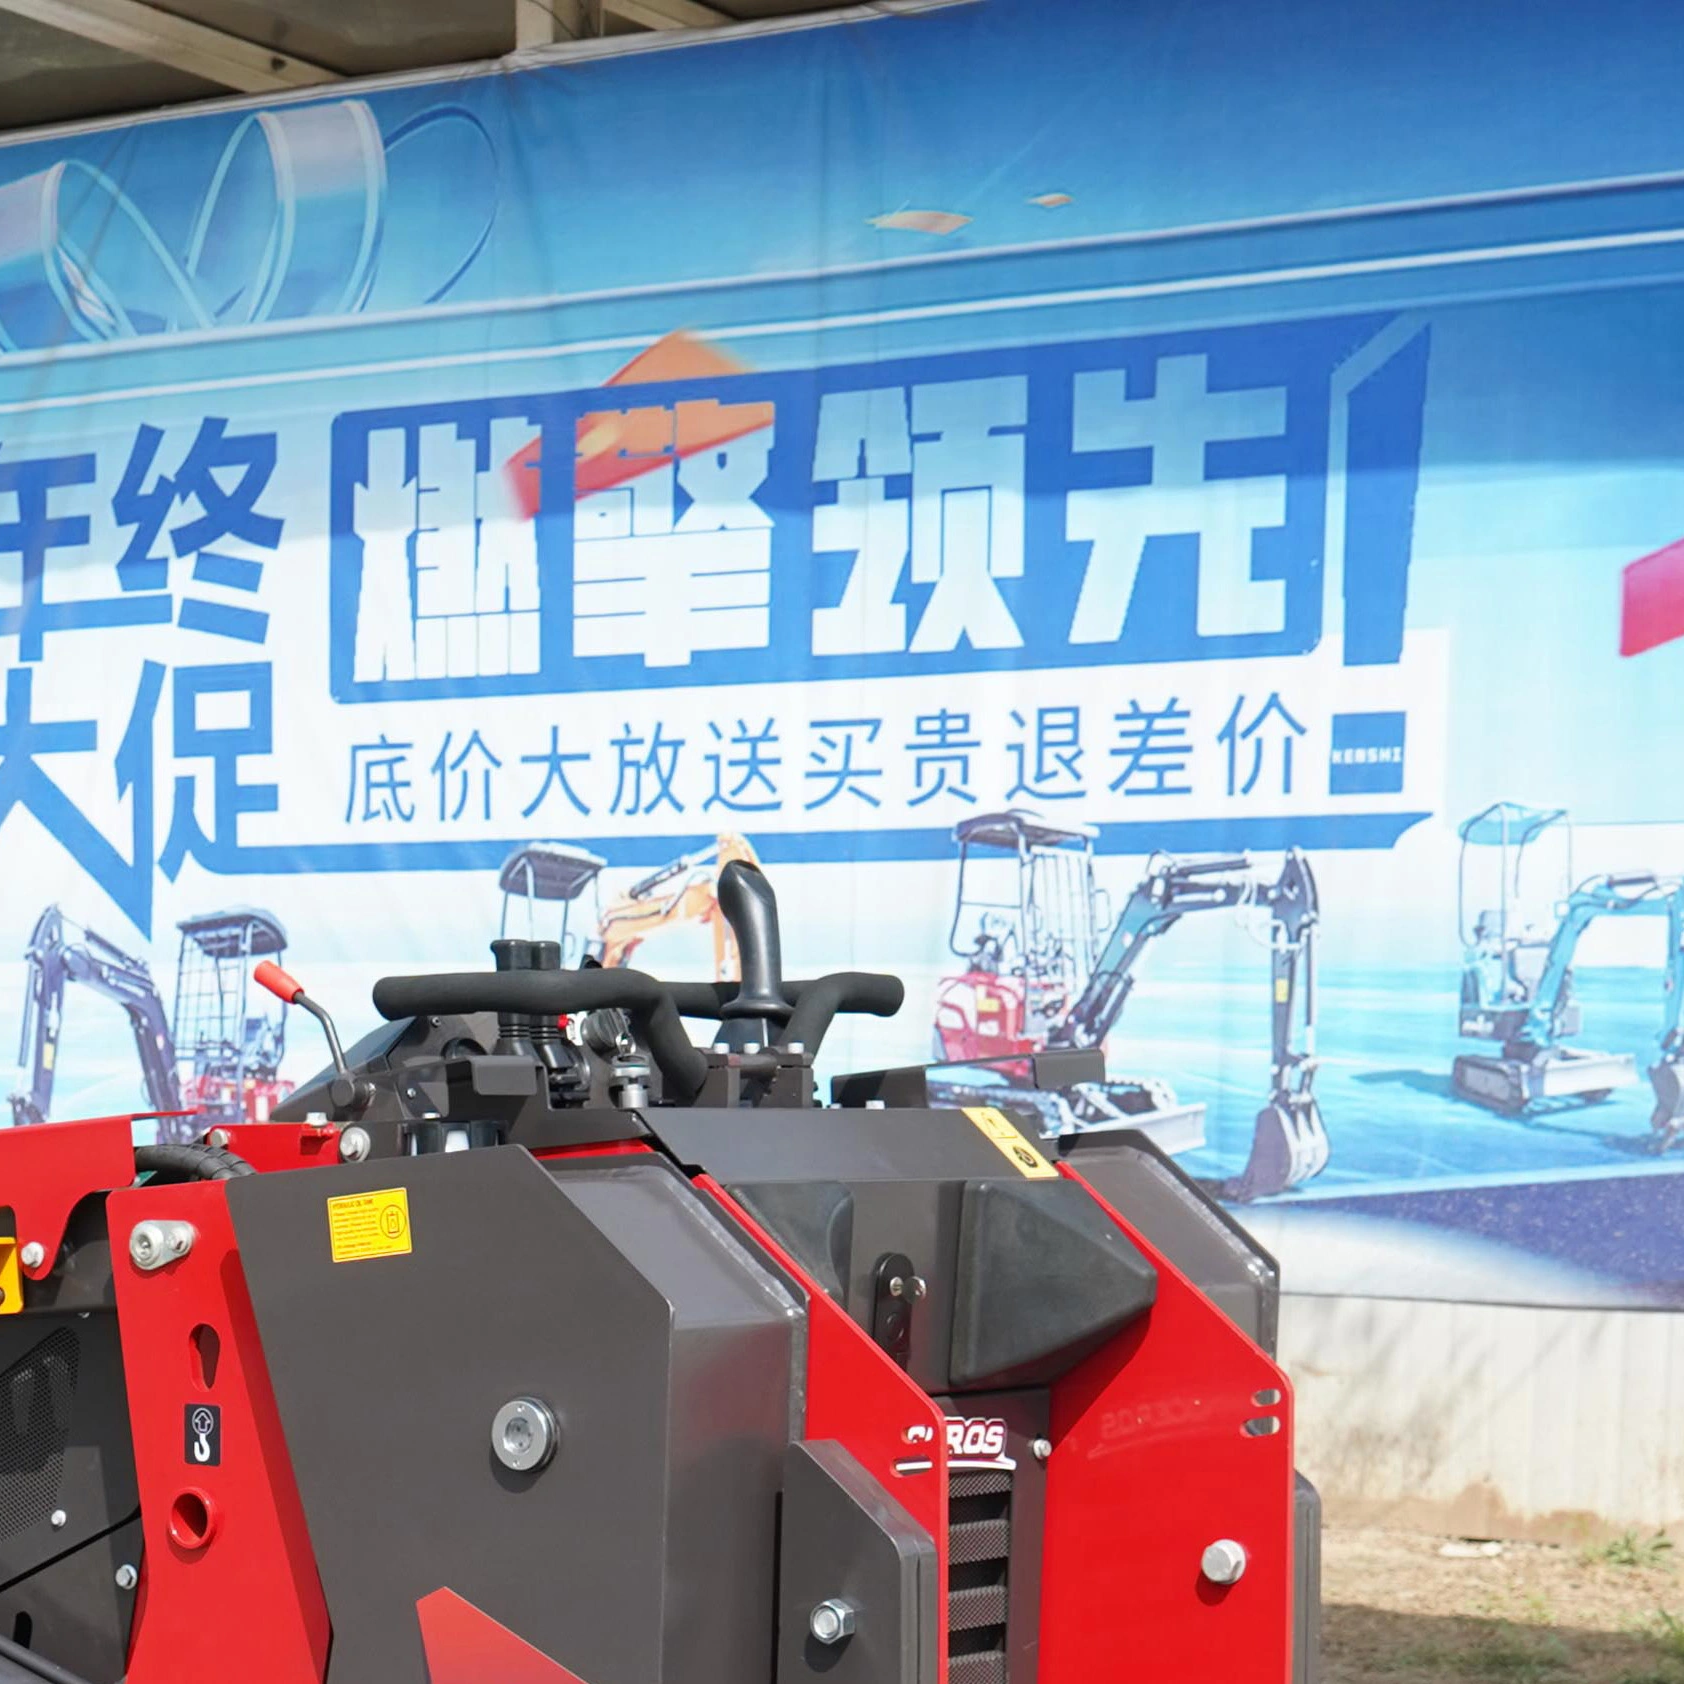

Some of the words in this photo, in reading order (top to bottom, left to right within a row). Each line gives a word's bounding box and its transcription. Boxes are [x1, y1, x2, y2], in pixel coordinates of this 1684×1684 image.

[345, 692, 1307, 824] 底价大放送买贵退差价
